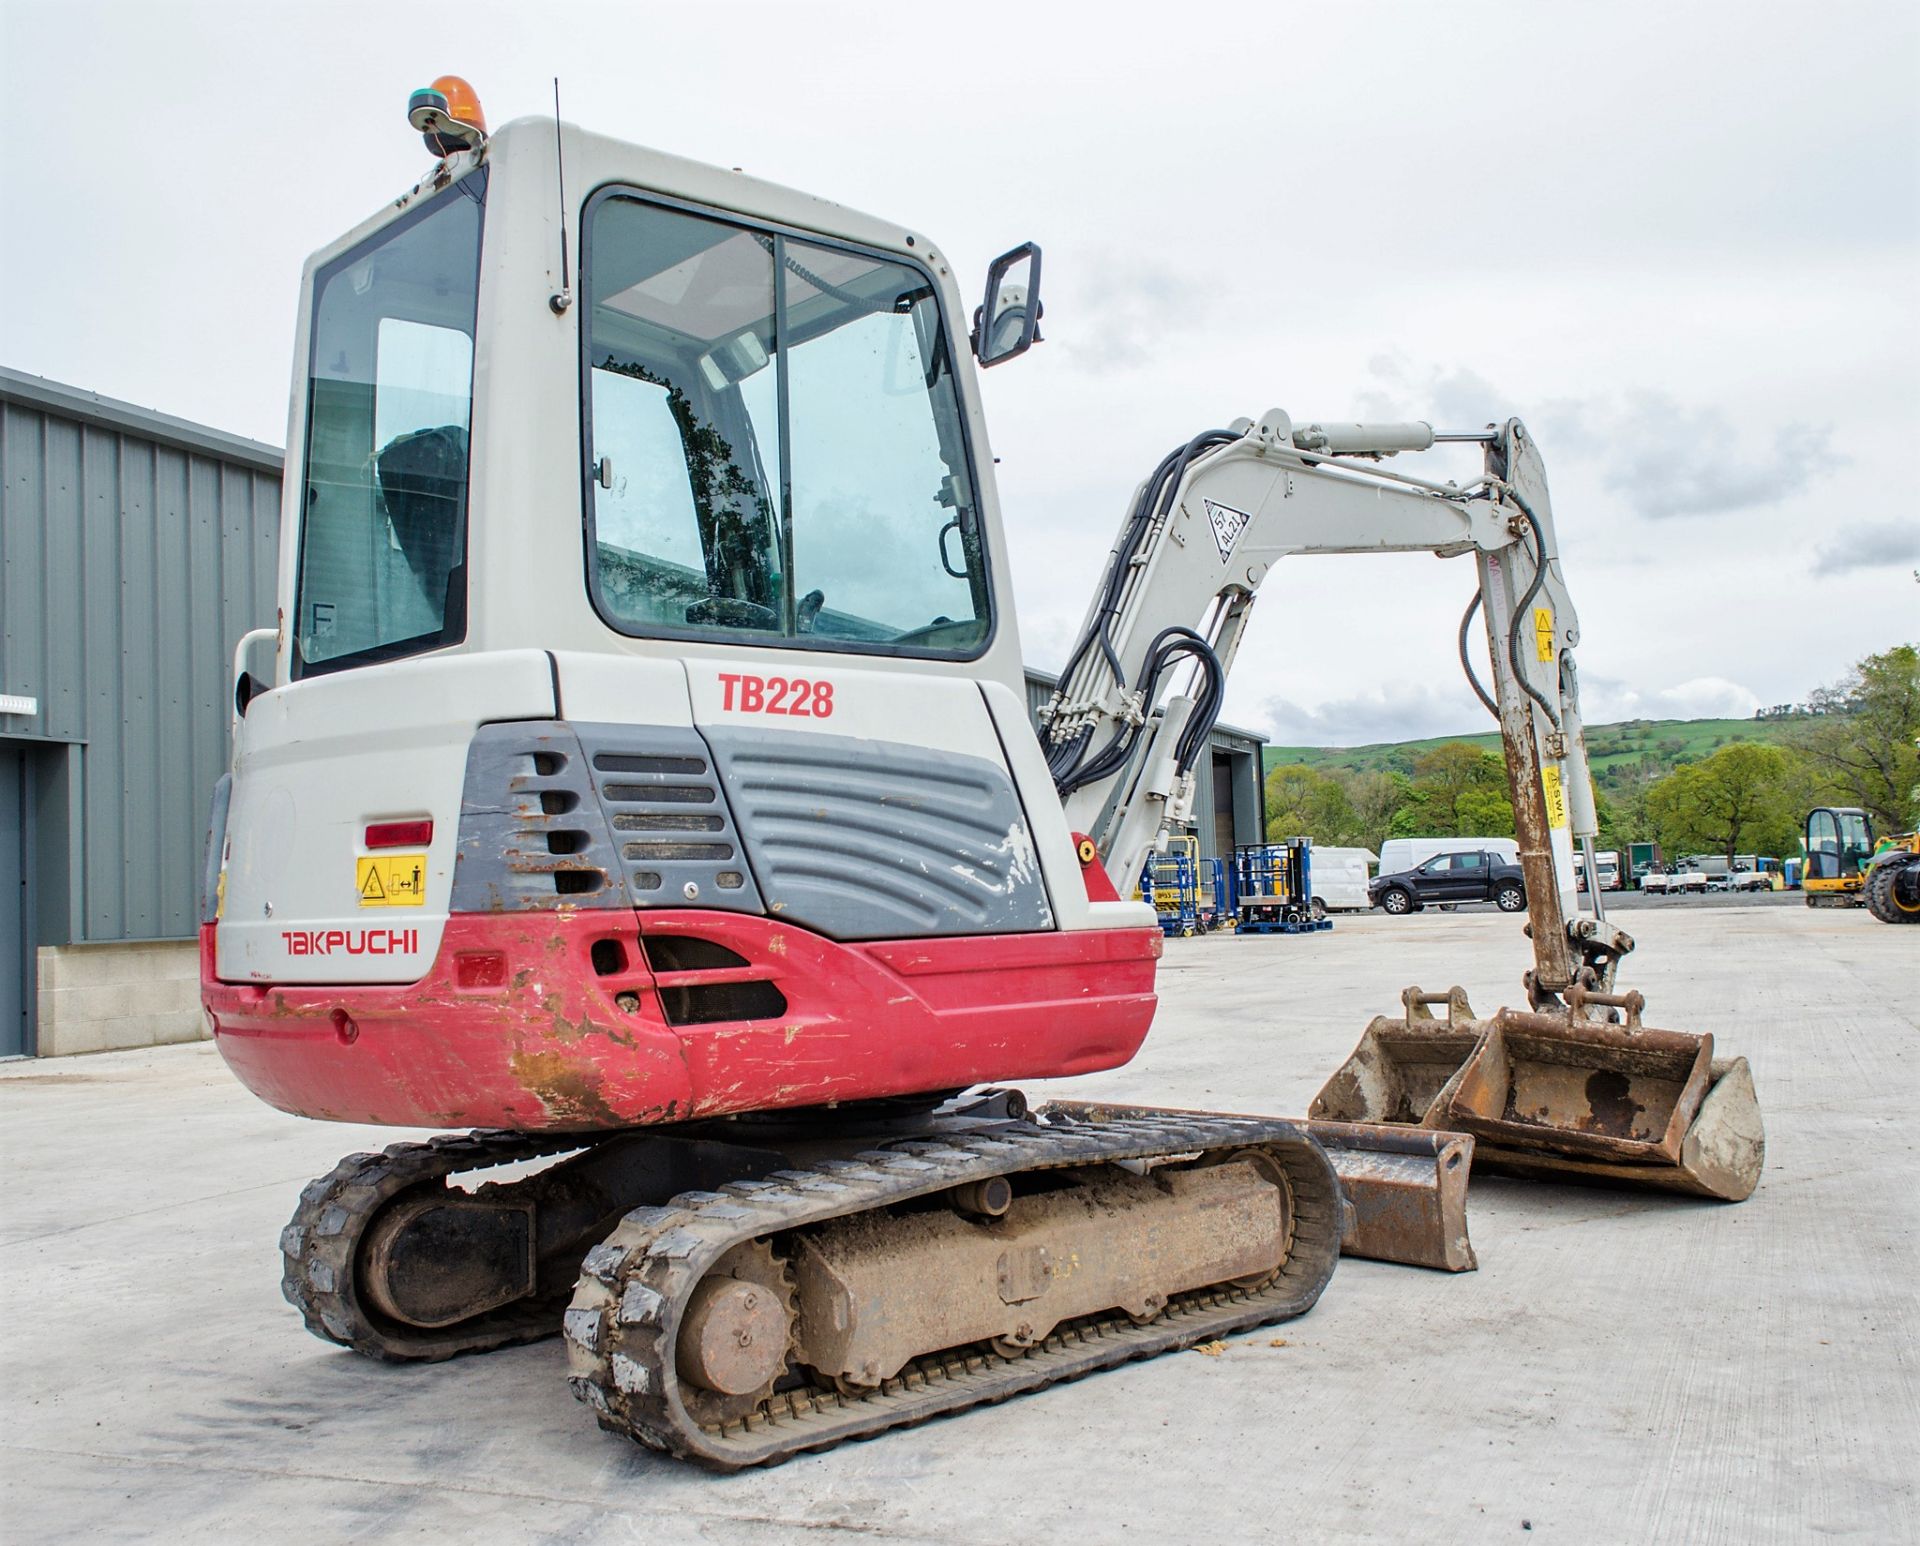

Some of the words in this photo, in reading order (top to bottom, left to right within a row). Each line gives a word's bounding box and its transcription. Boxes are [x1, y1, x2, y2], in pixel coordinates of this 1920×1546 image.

[1215, 511, 1226, 530] 57
[312, 603, 335, 635] F
[718, 673, 834, 718] TB228
[1554, 789, 1564, 821] SWL
